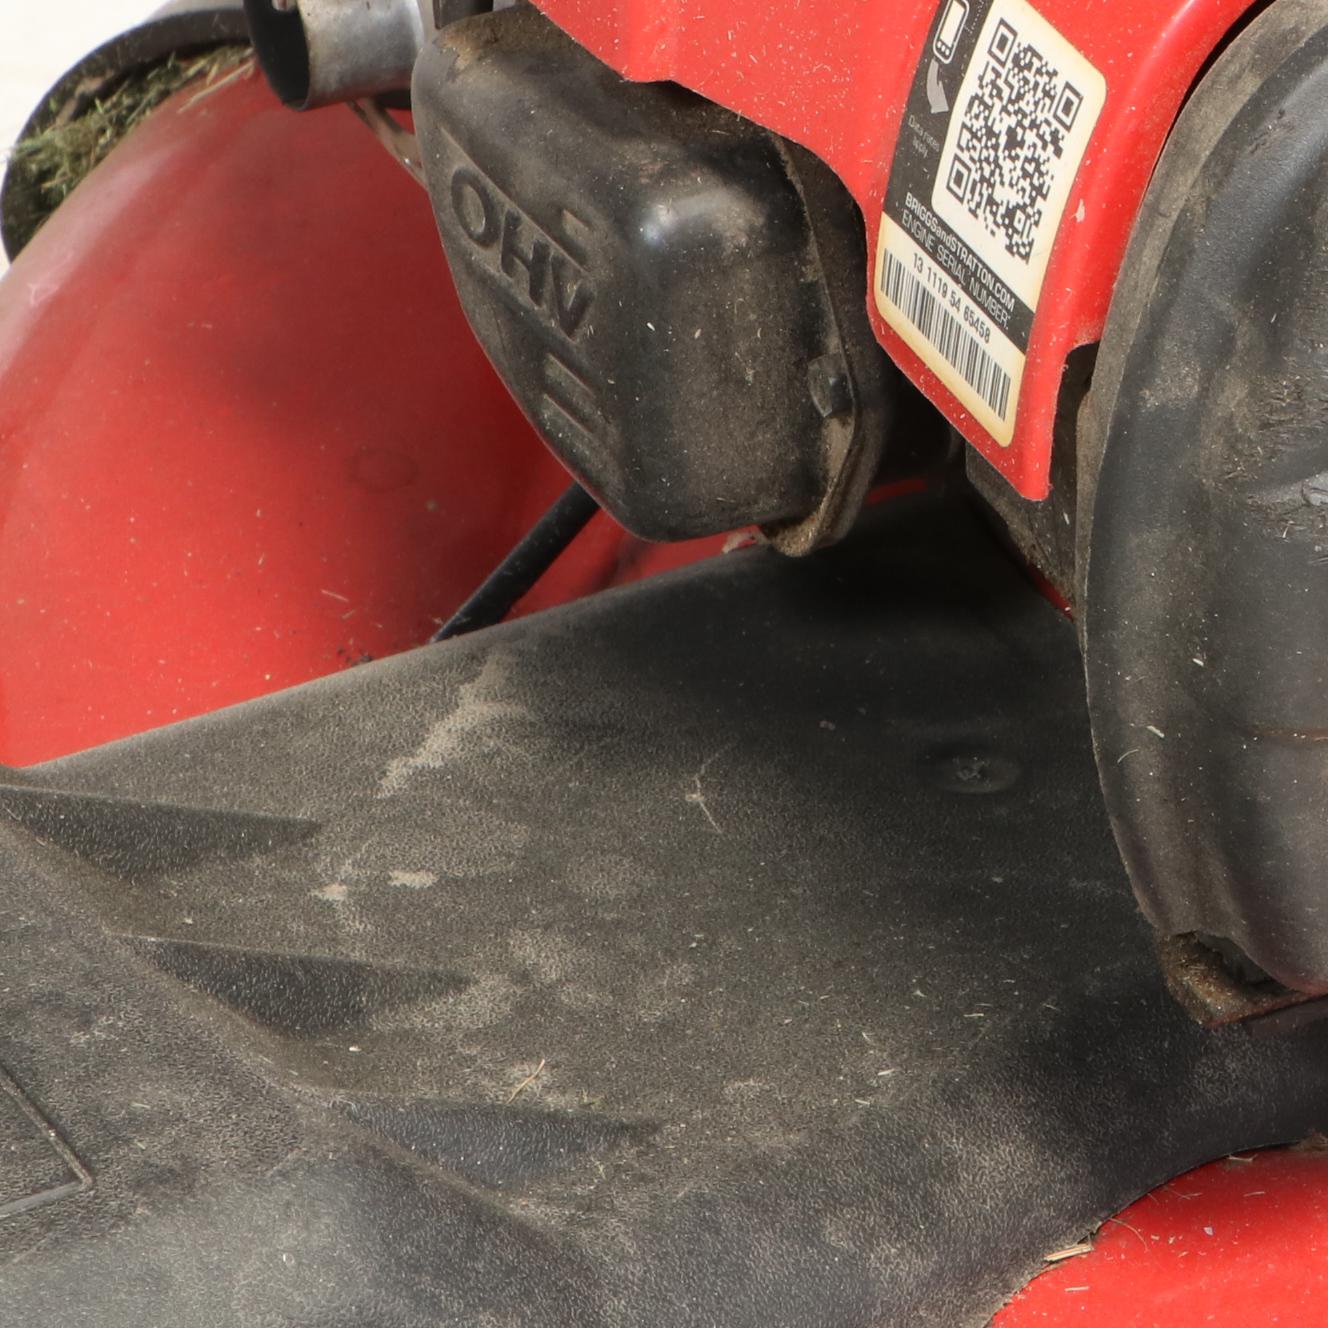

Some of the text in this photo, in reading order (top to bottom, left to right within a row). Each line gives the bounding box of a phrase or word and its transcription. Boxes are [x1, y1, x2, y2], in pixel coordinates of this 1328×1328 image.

[450, 167, 597, 343] OHV
[902, 209, 936, 252] ENGINE
[937, 245, 967, 286] SERIAL
[905, 192, 1015, 313] BRIGGSandSTRATTON.COM
[913, 252, 991, 344] 13 1119 54 65458
